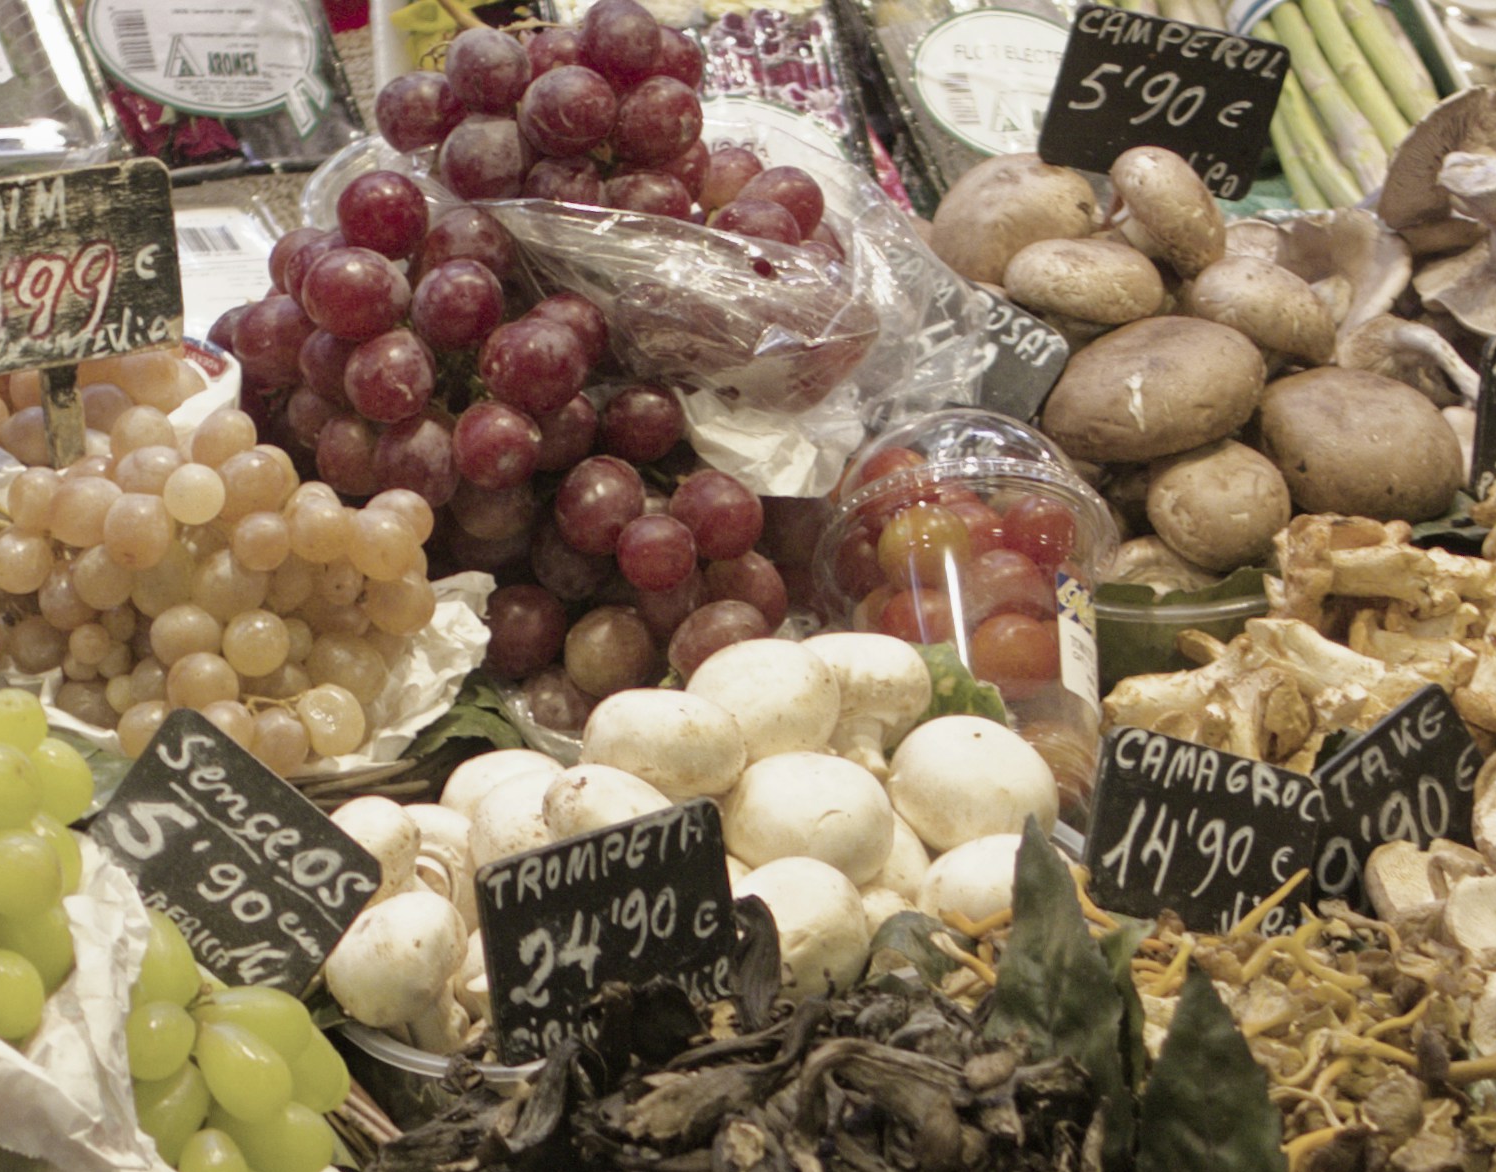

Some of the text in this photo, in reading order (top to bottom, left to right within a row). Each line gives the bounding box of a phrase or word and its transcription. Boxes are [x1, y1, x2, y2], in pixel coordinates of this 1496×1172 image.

[1078, 8, 1284, 79] CAMPEROL
[1068, 62, 1207, 128] 5'90
[107, 801, 273, 923] 5'90
[487, 808, 703, 911] TROMPETA
[1102, 798, 1255, 897] 14'90
[509, 885, 678, 1006] 24'90
